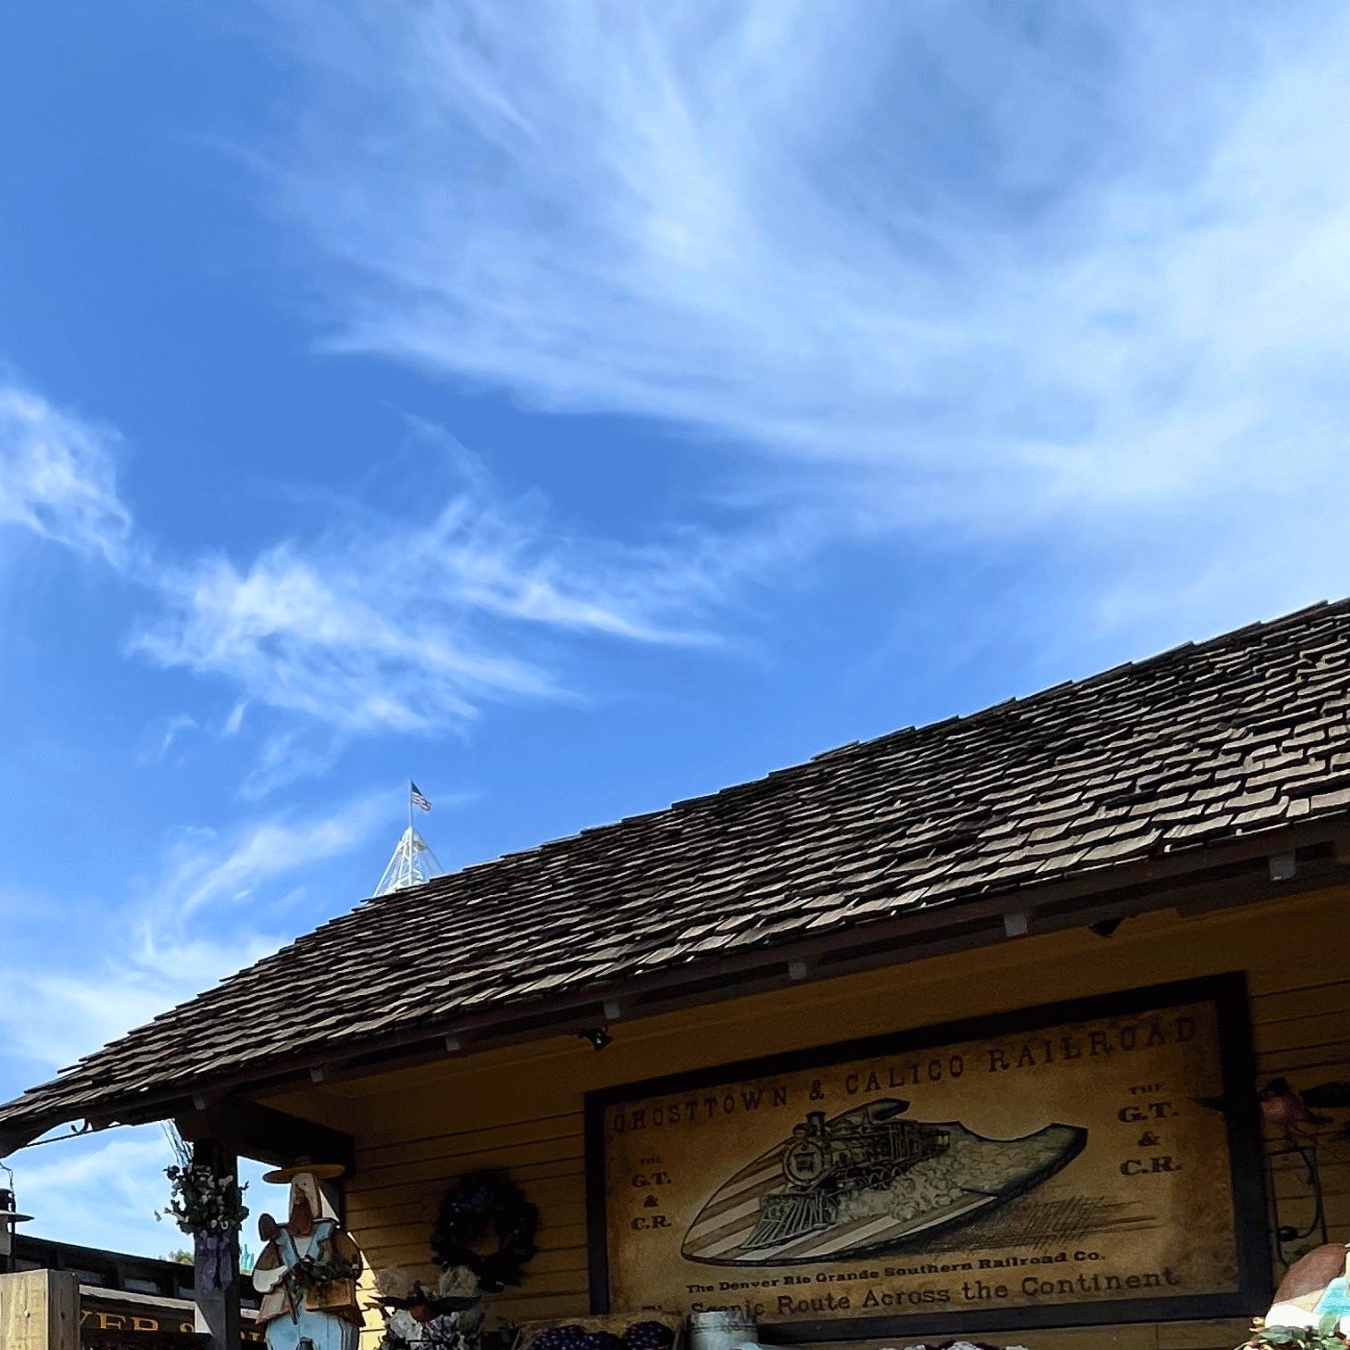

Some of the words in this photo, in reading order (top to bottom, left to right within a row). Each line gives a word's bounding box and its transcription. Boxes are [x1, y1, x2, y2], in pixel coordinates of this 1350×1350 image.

[809, 1079, 825, 1100] &
[845, 1055, 964, 1095] CALICO
[987, 1016, 1196, 1073] RAILROAD
[1118, 1101, 1179, 1123] G.T.
[1137, 1130, 1161, 1147] &
[1120, 1156, 1183, 1176] C.R.
[631, 1171, 672, 1188] G.T.
[631, 1215, 672, 1230] C.R.
[686, 1283, 715, 1295] The
[718, 1277, 780, 1291] Denver
[782, 1275, 811, 1286] Rio
[815, 1269, 880, 1283] Grande
[884, 1261, 973, 1277] Southern
[978, 1251, 1068, 1271] Railroad
[1073, 1250, 1107, 1262] Co.
[776, 1292, 851, 1316] Route
[861, 1286, 951, 1309] Across
[960, 1280, 1010, 1302] the
[1021, 1266, 1181, 1297] Continent
